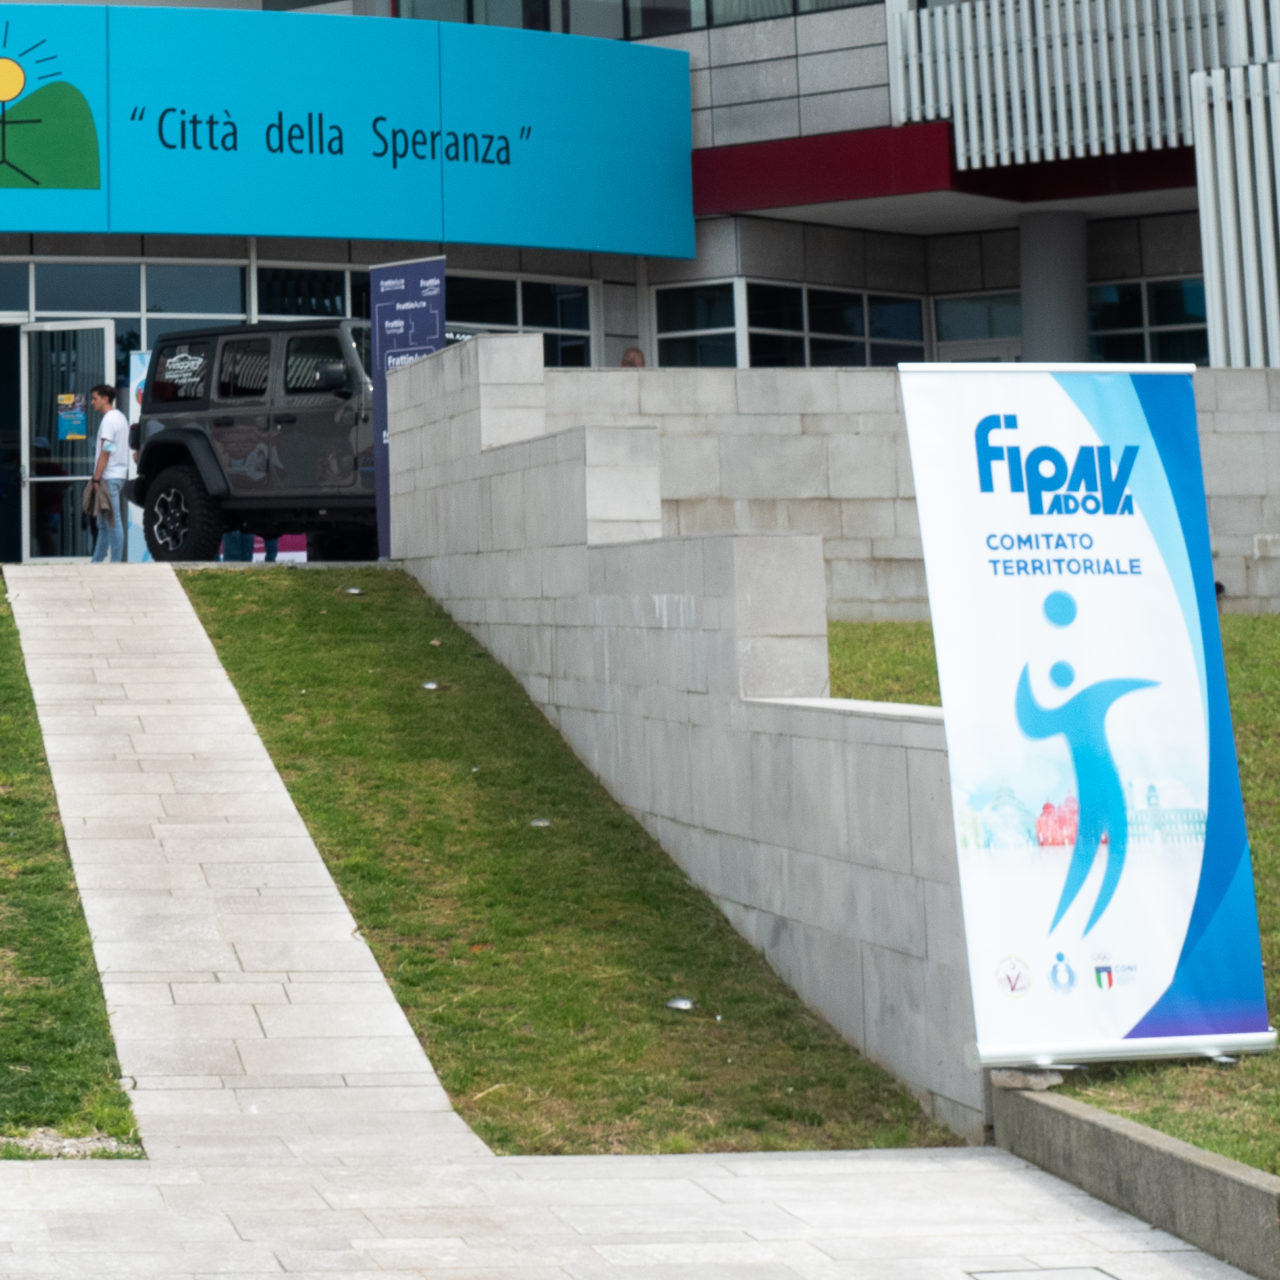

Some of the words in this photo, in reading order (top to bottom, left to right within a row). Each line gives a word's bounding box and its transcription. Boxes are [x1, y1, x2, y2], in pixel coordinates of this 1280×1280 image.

[265, 111, 344, 155] della
[986, 533, 1094, 551] COMITATO
[989, 559, 1141, 576] TERRITORIALE
